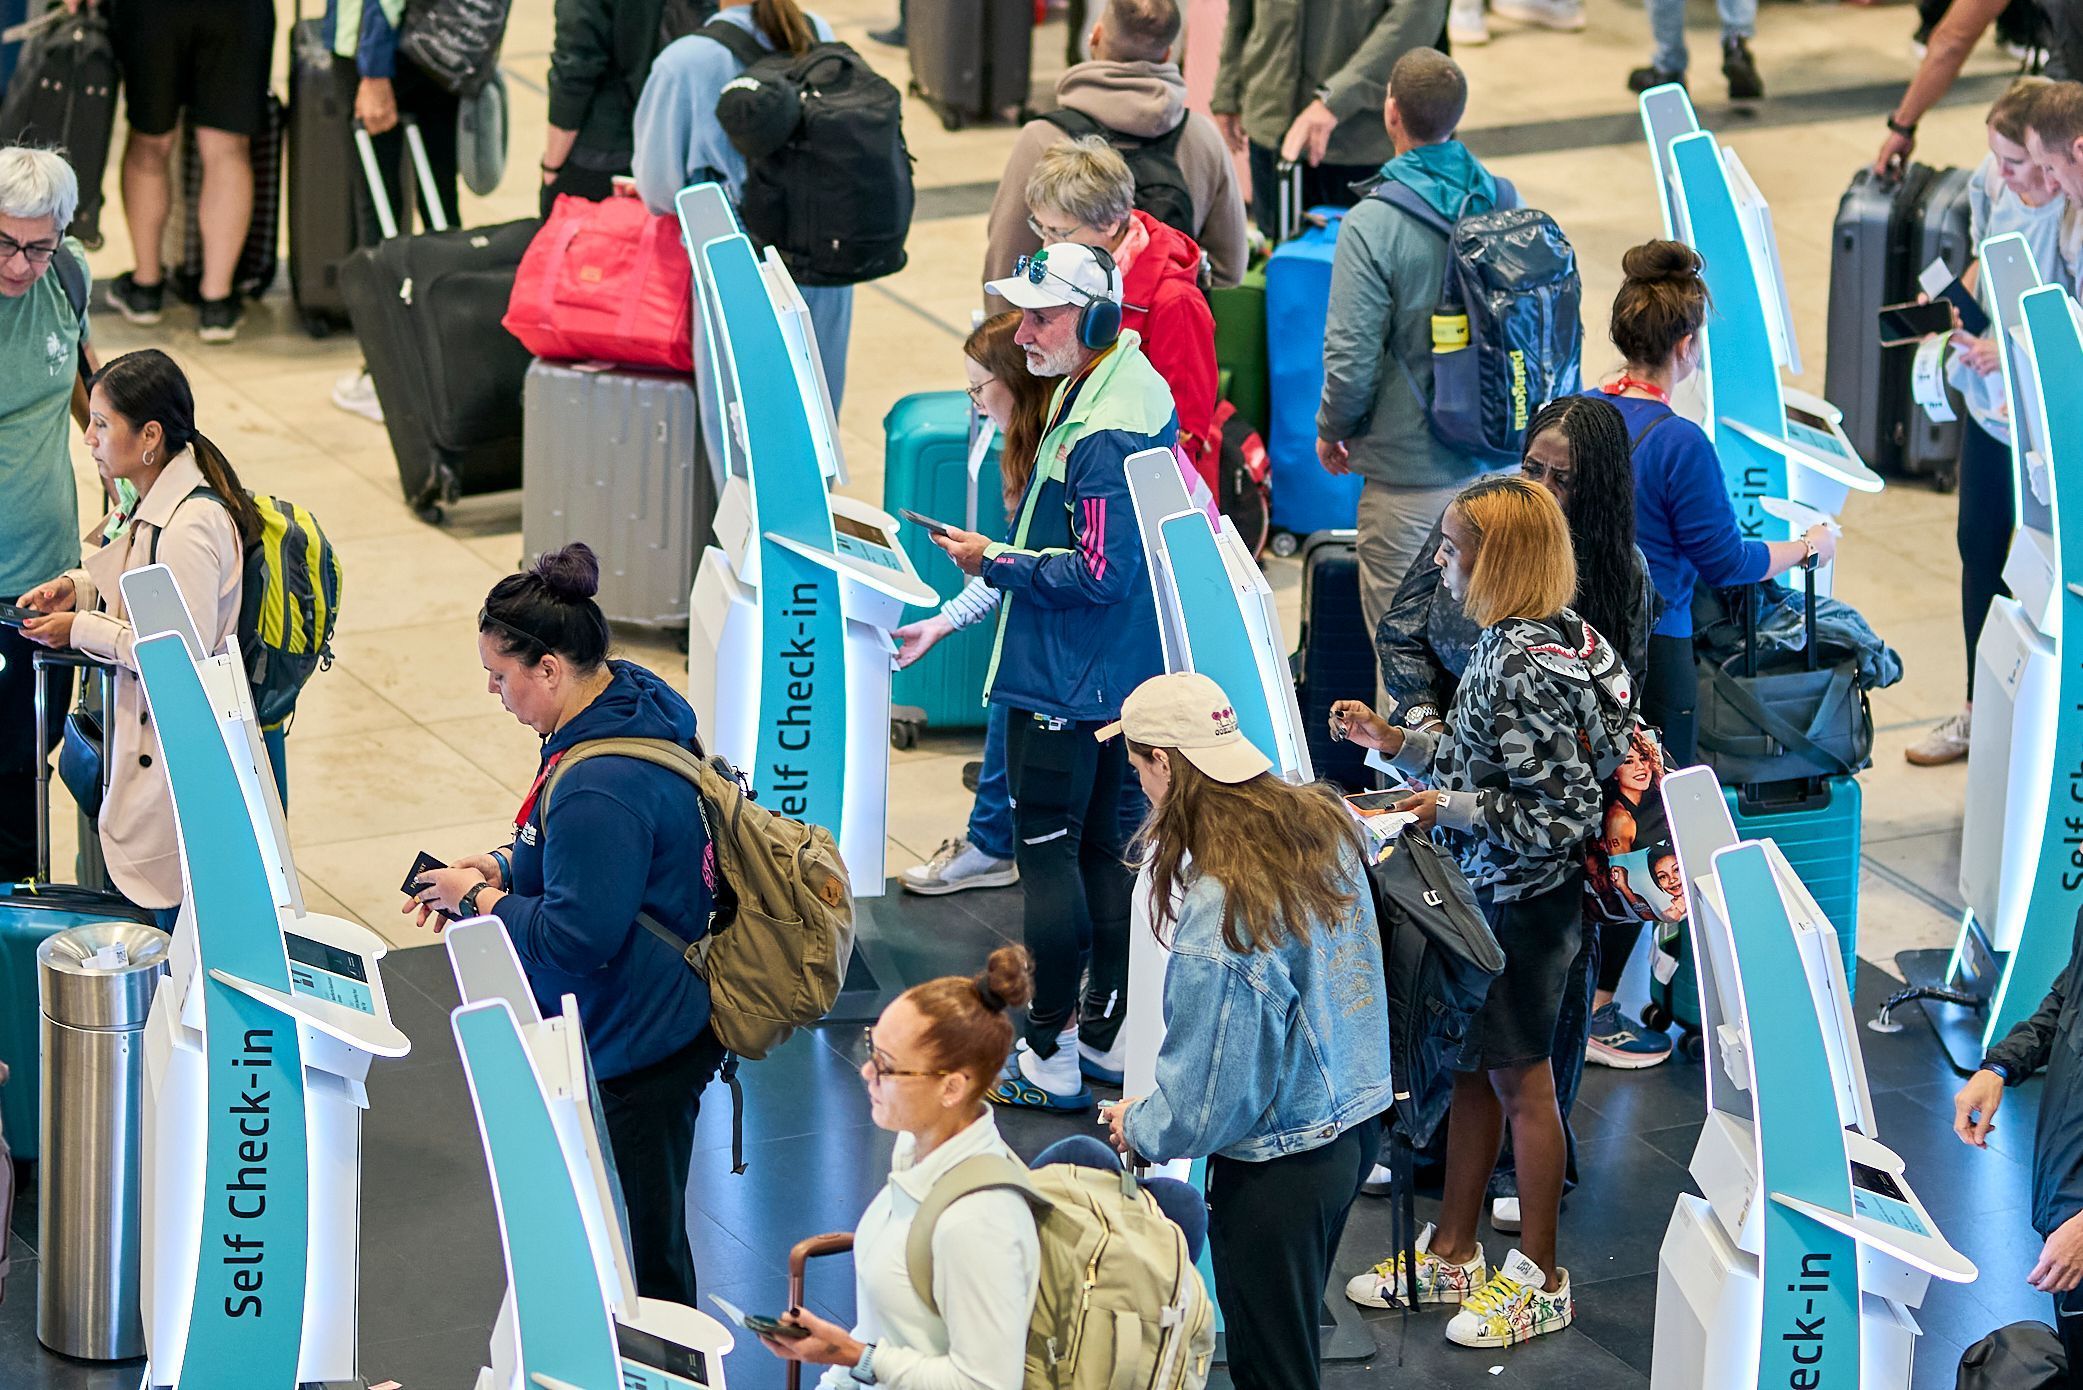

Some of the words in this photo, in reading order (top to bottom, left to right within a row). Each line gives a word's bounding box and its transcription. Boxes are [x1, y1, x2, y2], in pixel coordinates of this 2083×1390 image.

[1509, 349, 1529, 431] patagonia
[1733, 468, 1768, 538] k-in
[776, 583, 818, 750] Check-in
[773, 764, 808, 825] elf
[226, 1029, 273, 1219] Check-in
[223, 1234, 264, 1318] Self
[1782, 1253, 1832, 1390] eck-in
